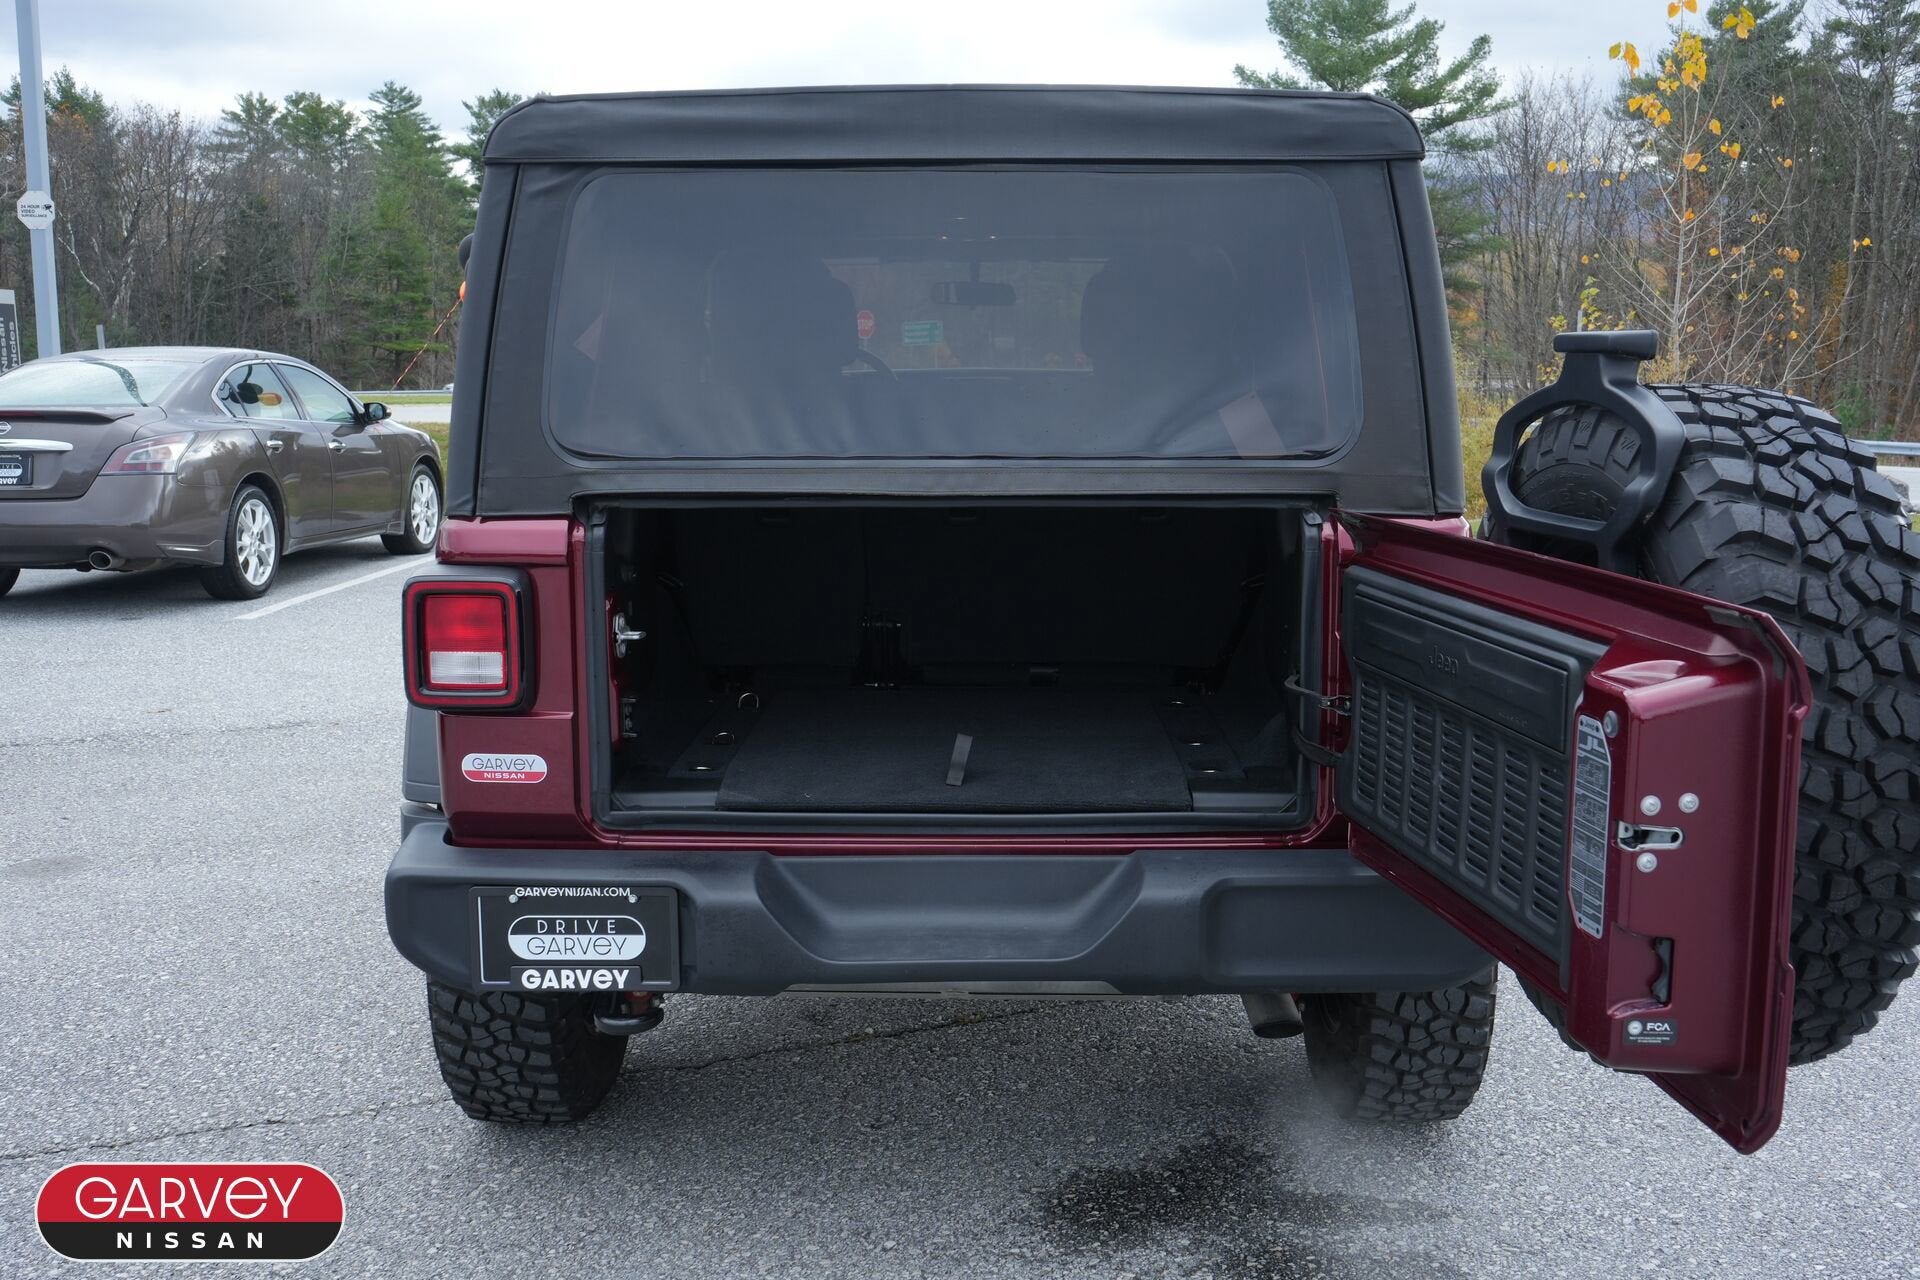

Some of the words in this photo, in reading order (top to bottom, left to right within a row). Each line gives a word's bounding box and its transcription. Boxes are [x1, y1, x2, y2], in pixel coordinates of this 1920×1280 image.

[857, 319, 873, 330] STOP
[1428, 645, 1459, 674] Jeep
[1579, 735, 1606, 754] JL
[537, 919, 617, 934] DRIVE
[1646, 1022, 1671, 1032] FCA
